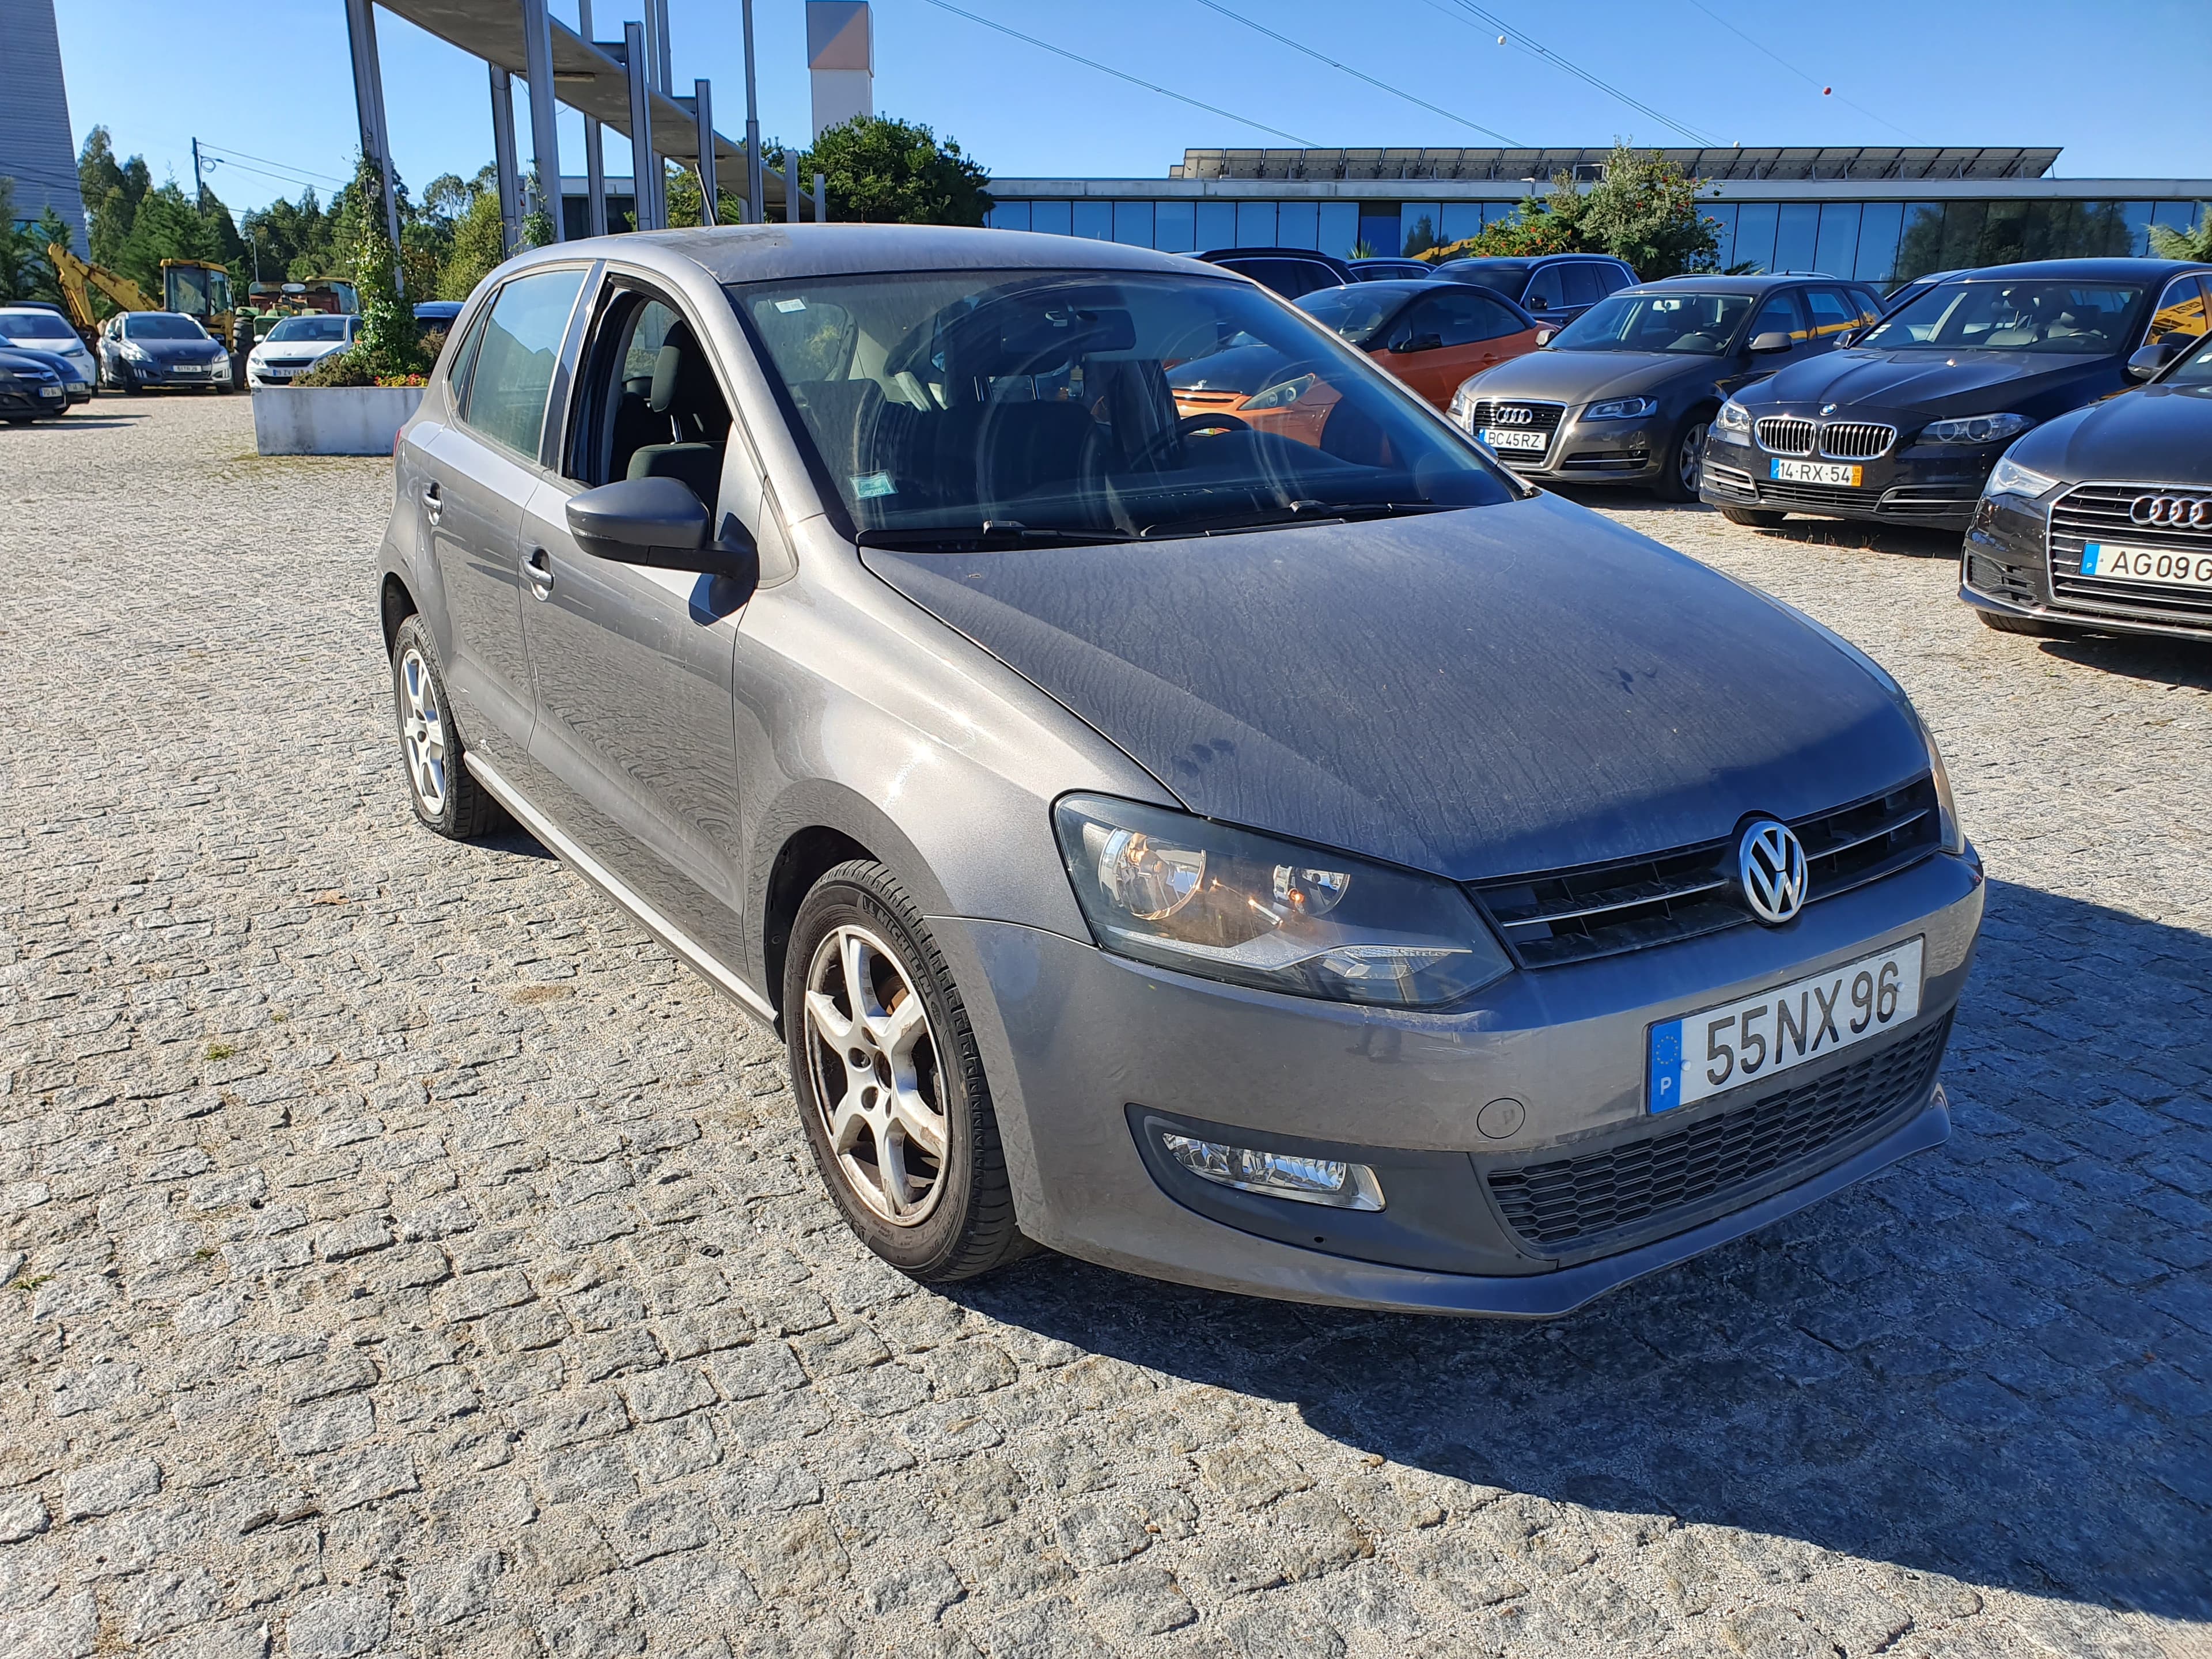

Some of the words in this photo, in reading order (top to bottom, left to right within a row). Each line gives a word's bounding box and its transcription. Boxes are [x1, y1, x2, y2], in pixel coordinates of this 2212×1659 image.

[1488, 432, 1540, 448] BC45RZ
[876, 911, 933, 996] MICHELIN
[1660, 1077, 1672, 1096] P
